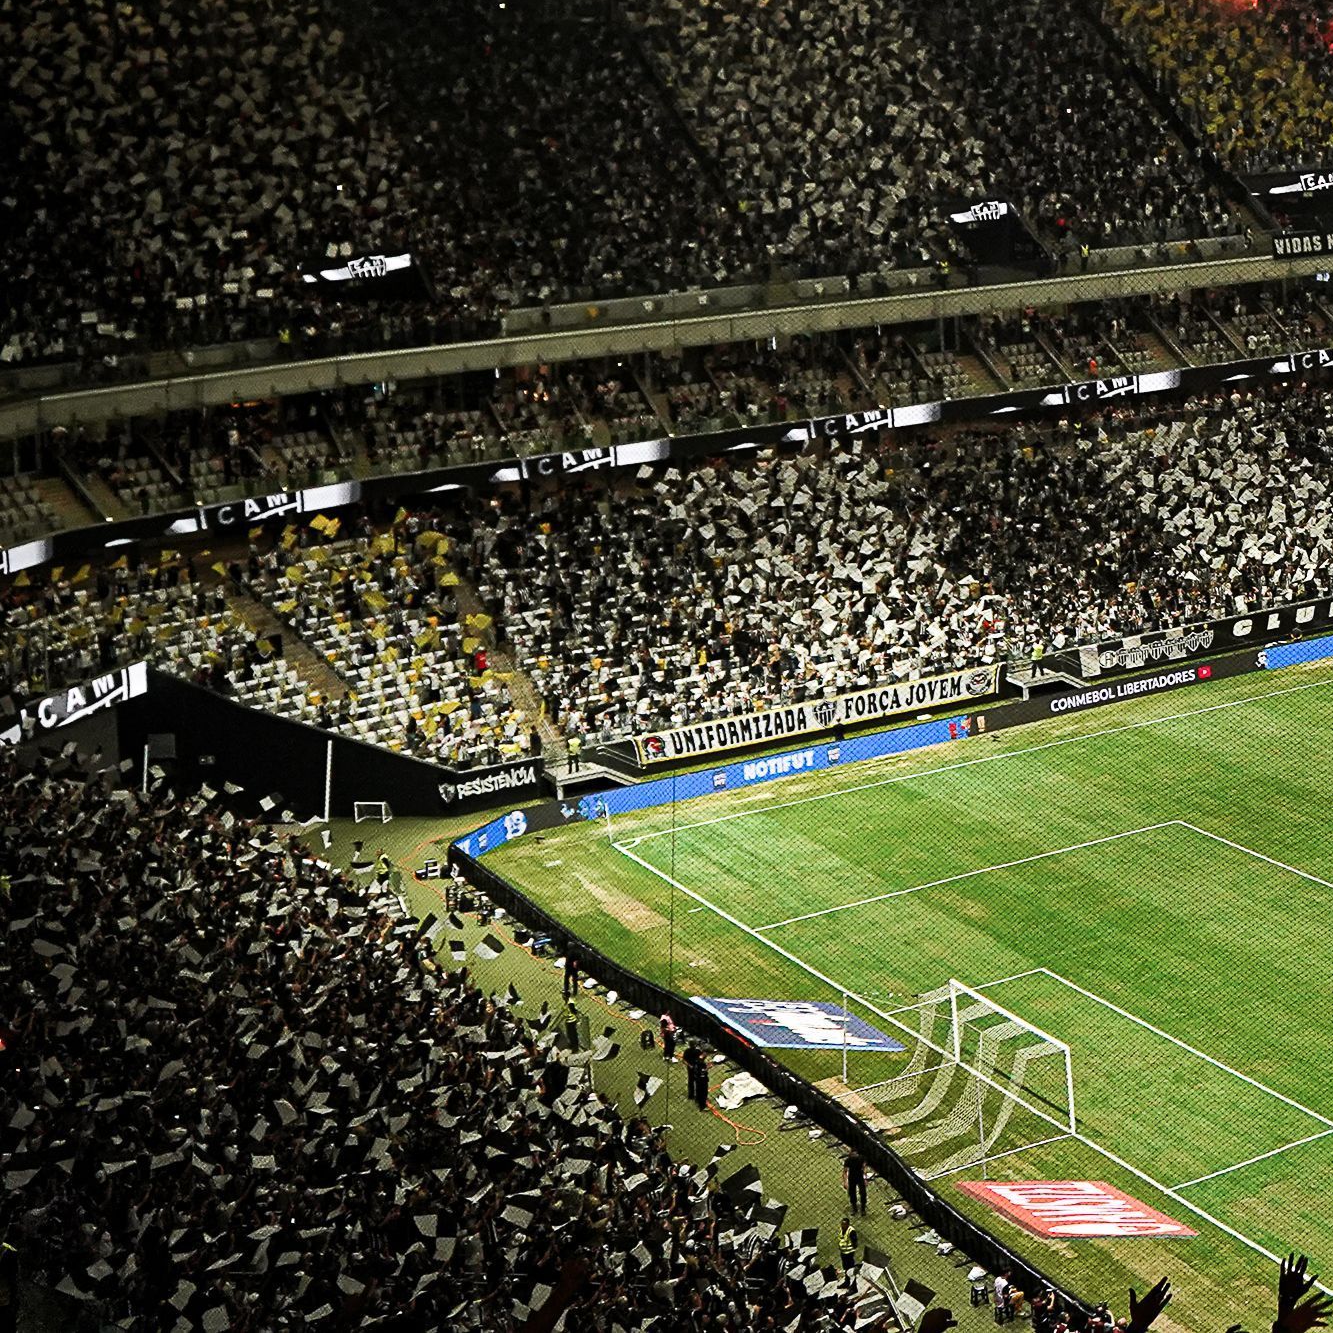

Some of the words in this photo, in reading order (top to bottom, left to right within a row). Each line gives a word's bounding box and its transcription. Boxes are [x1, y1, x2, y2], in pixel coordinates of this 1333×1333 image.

[1274, 235, 1322, 255] VIDAS
[1078, 377, 1128, 400] CAM
[825, 410, 883, 435] CAM
[538, 448, 603, 475] CAM
[217, 493, 289, 525] CAM
[38, 673, 115, 728] CAM
[1051, 682, 1116, 712] CONMEBOL
[1117, 669, 1196, 697] LIBERTADORES
[671, 708, 807, 755] UNIFORMIZADA
[906, 675, 962, 707] JOVEM
[743, 750, 815, 781] NOTIFUT
